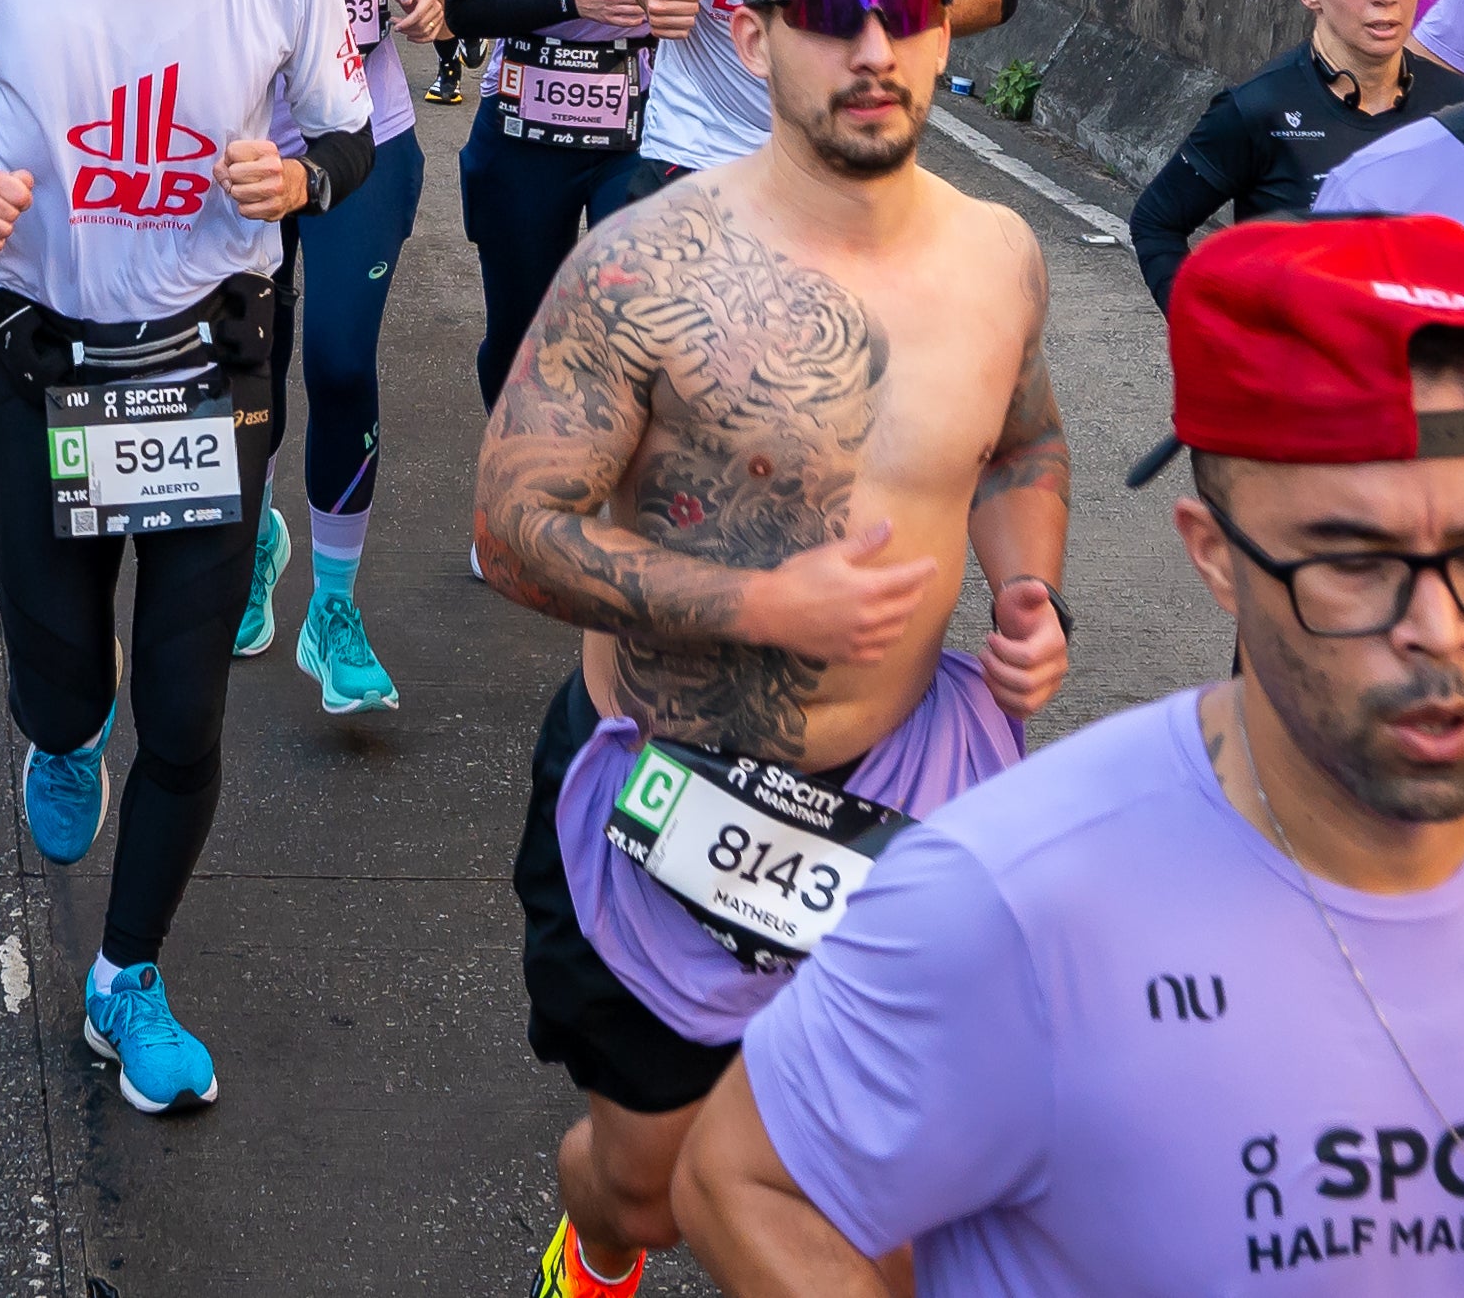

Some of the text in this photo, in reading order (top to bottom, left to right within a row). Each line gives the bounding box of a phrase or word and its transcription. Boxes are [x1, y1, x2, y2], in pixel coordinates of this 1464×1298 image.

[554, 48, 598, 60] SPCITY
[554, 59, 599, 69] MARATHON
[506, 69, 517, 89] E
[534, 79, 622, 109] 16955
[551, 113, 602, 123] STEPHANIE
[72, 165, 211, 217] DLB
[125, 388, 186, 404] SPCITY
[125, 403, 187, 417] MARATHON
[245, 409, 269, 425] asics
[62, 438, 80, 467] C
[115, 434, 220, 474] 5942
[140, 482, 199, 496] ALBERTO
[640, 770, 673, 810] C
[762, 765, 845, 817] SPCITY
[754, 785, 834, 831] MARATHON
[707, 823, 841, 913] 8143
[713, 888, 799, 938] MATHEUS
[1246, 1216, 1376, 1274] HALF
